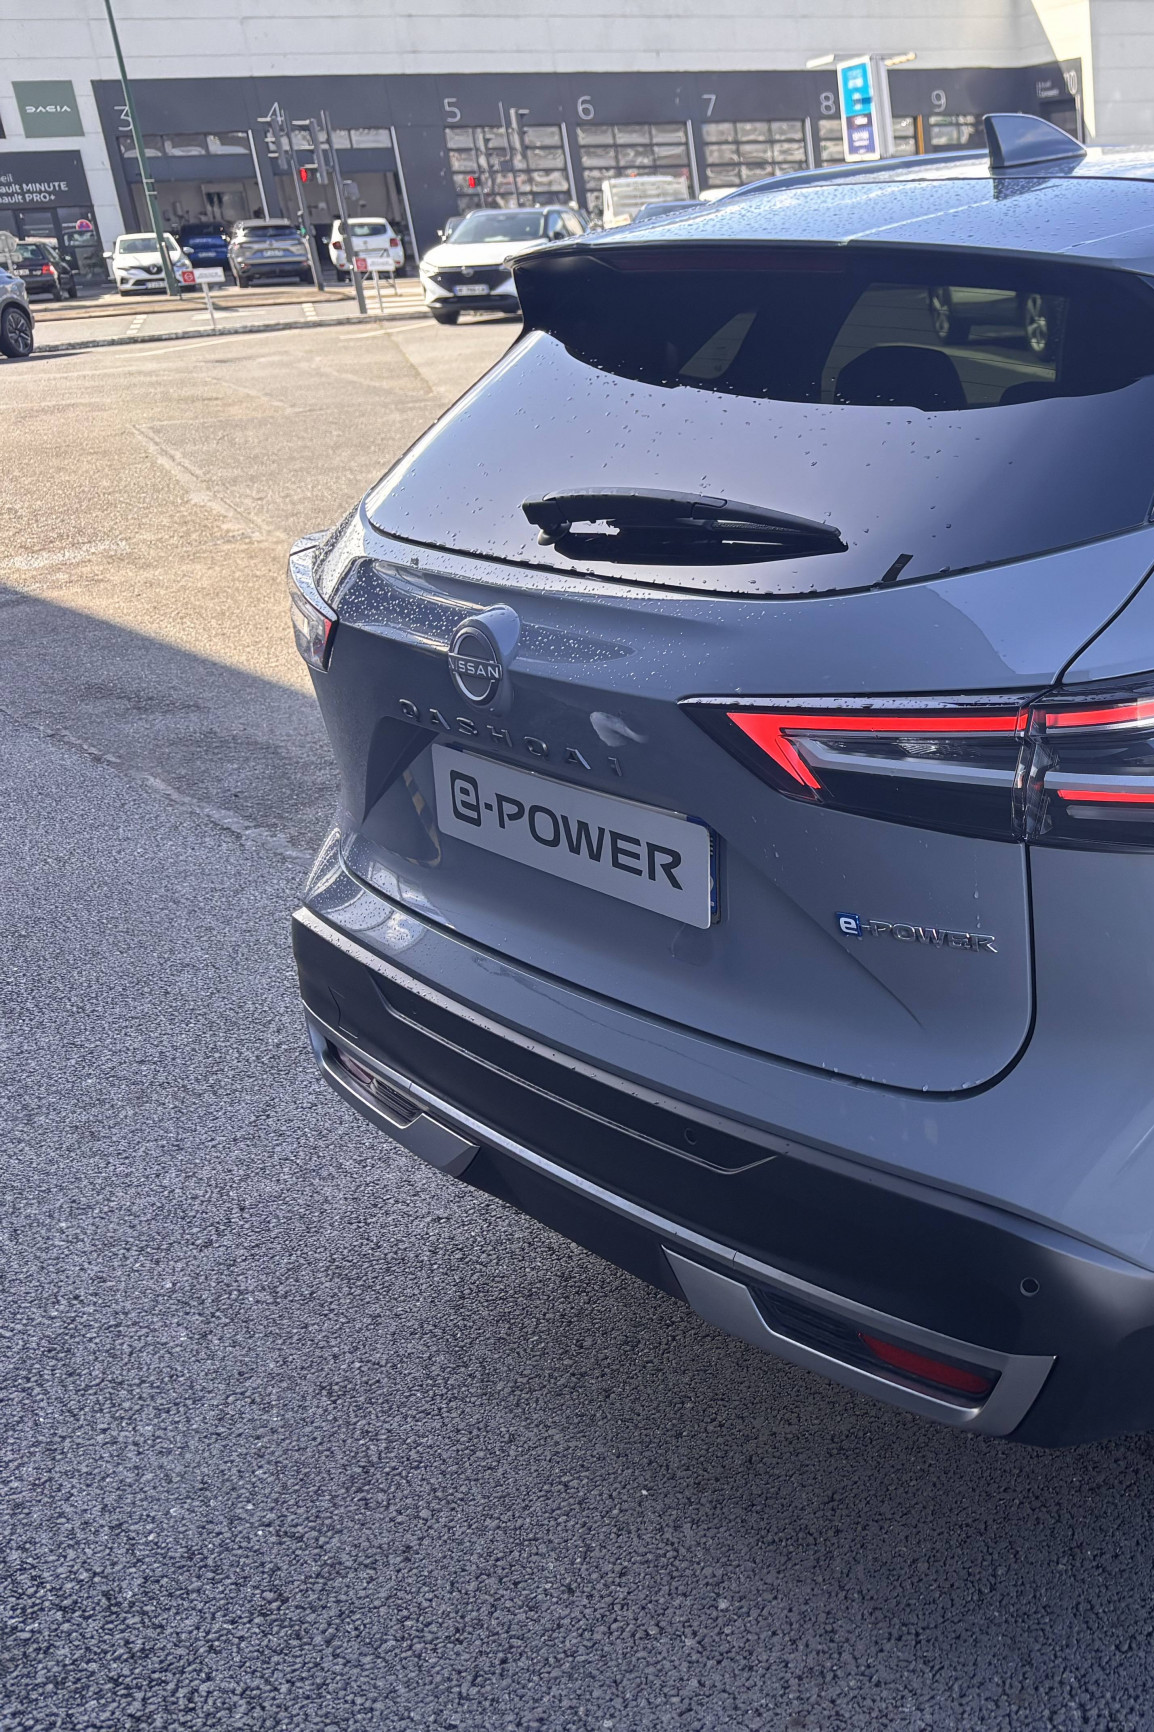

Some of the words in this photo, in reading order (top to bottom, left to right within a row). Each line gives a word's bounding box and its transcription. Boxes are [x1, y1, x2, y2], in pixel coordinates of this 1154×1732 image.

[25, 105, 71, 113] DACIA
[444, 98, 461, 122] 5
[577, 96, 595, 119] 6
[701, 94, 717, 117] 7
[819, 92, 836, 115] 8
[931, 90, 947, 112] 9
[114, 105, 133, 131] 3
[23, 182, 68, 192] MINUTE
[25, 193, 56, 202] PRO+
[449, 653, 501, 679] NISSAN
[399, 699, 623, 776] QASHQAI
[449, 769, 683, 891] e-POWER
[836, 911, 998, 953] e-POWER
